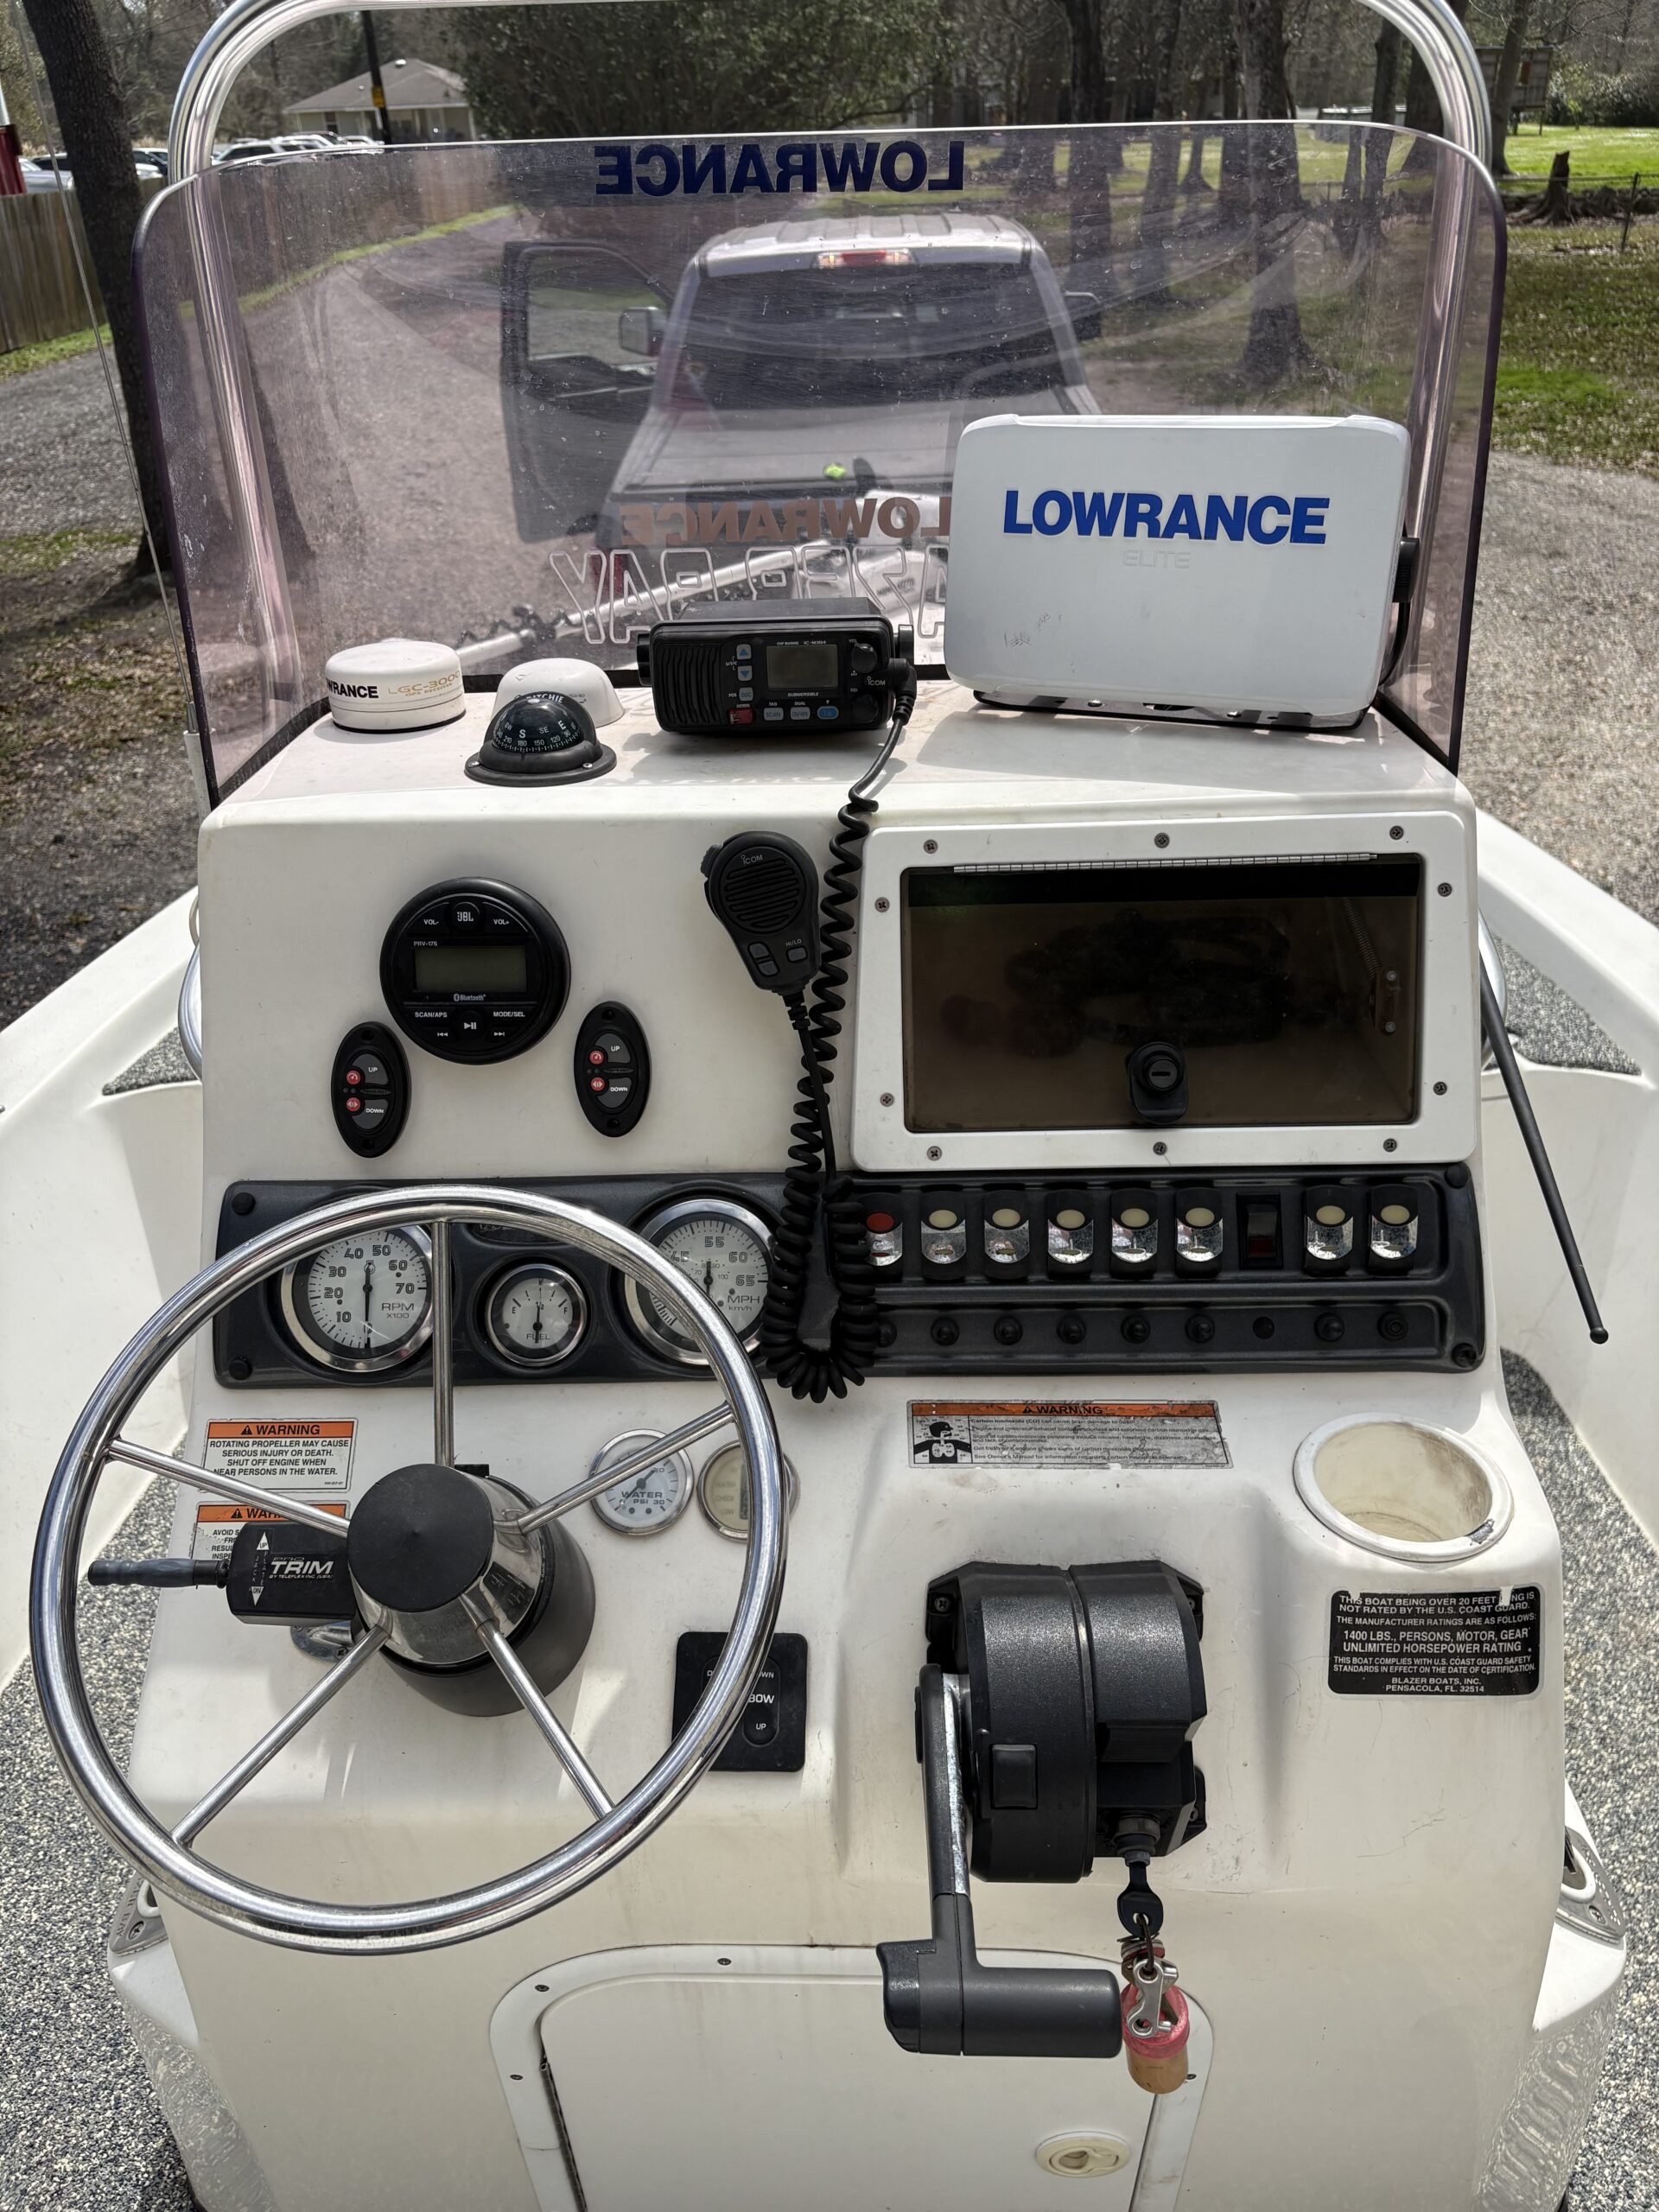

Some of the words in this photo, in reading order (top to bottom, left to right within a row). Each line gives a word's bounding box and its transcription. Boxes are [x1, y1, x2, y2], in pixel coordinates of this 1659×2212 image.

[1002, 488, 1332, 544] LOWRANCE
[1124, 550, 1191, 569] ELITE
[327, 677, 379, 699] WRANCE
[388, 670, 461, 695] LGC-3000
[538, 726, 550, 734] SE
[557, 720, 567, 730] E
[518, 729, 526, 739] S
[550, 734, 561, 743] 120
[456, 912, 474, 922] JBL
[704, 1236, 725, 1248] 55
[344, 1248, 364, 1259] 40
[372, 1244, 391, 1256] 50
[671, 1251, 690, 1262] 45
[728, 1251, 748, 1263] 60
[389, 1260, 408, 1271] 60
[328, 1266, 346, 1277] 30
[735, 1274, 755, 1287] 65
[324, 1287, 344, 1299] 20
[395, 1283, 415, 1294] 70
[727, 1295, 760, 1304] MPH
[336, 1312, 352, 1323] 10
[1036, 1406, 1103, 1414] WARNING
[256, 1425, 321, 1435] WARNING
[213, 1468, 236, 1477] NEAR
[270, 1560, 334, 1574] TRIM
[1339, 1595, 1362, 1605] THIS
[1365, 1597, 1394, 1605] BOAT
[1471, 1596, 1496, 1605] FEET
[1339, 1605, 1360, 1613] NOT
[1459, 1605, 1492, 1614] COAST
[1494, 1602, 1530, 1612] GUARD.
[1336, 1616, 1353, 1624] THE
[1355, 1617, 1425, 1626] MANUFACTURER
[1497, 1613, 1537, 1624] FOLLOWS:
[1344, 1630, 1368, 1641] 1400
[1370, 1630, 1397, 1642] LBS.,
[1399, 1631, 1452, 1643] PERSONS,
[1456, 1631, 1497, 1643] MOTOR,
[1500, 1628, 1529, 1640] GEAR
[1343, 1642, 1401, 1653] UNLIMITED
[1402, 1643, 1481, 1654] HORSEPOWER
[1483, 1642, 1522, 1653] RATING
[1352, 1656, 1373, 1665] BOAT
[1504, 1656, 1531, 1664] SAFETY
[1481, 1663, 1535, 1675] CERTIFICATION.
[1428, 1677, 1462, 1686] BOATS,
[748, 1694, 775, 1704] BOW
